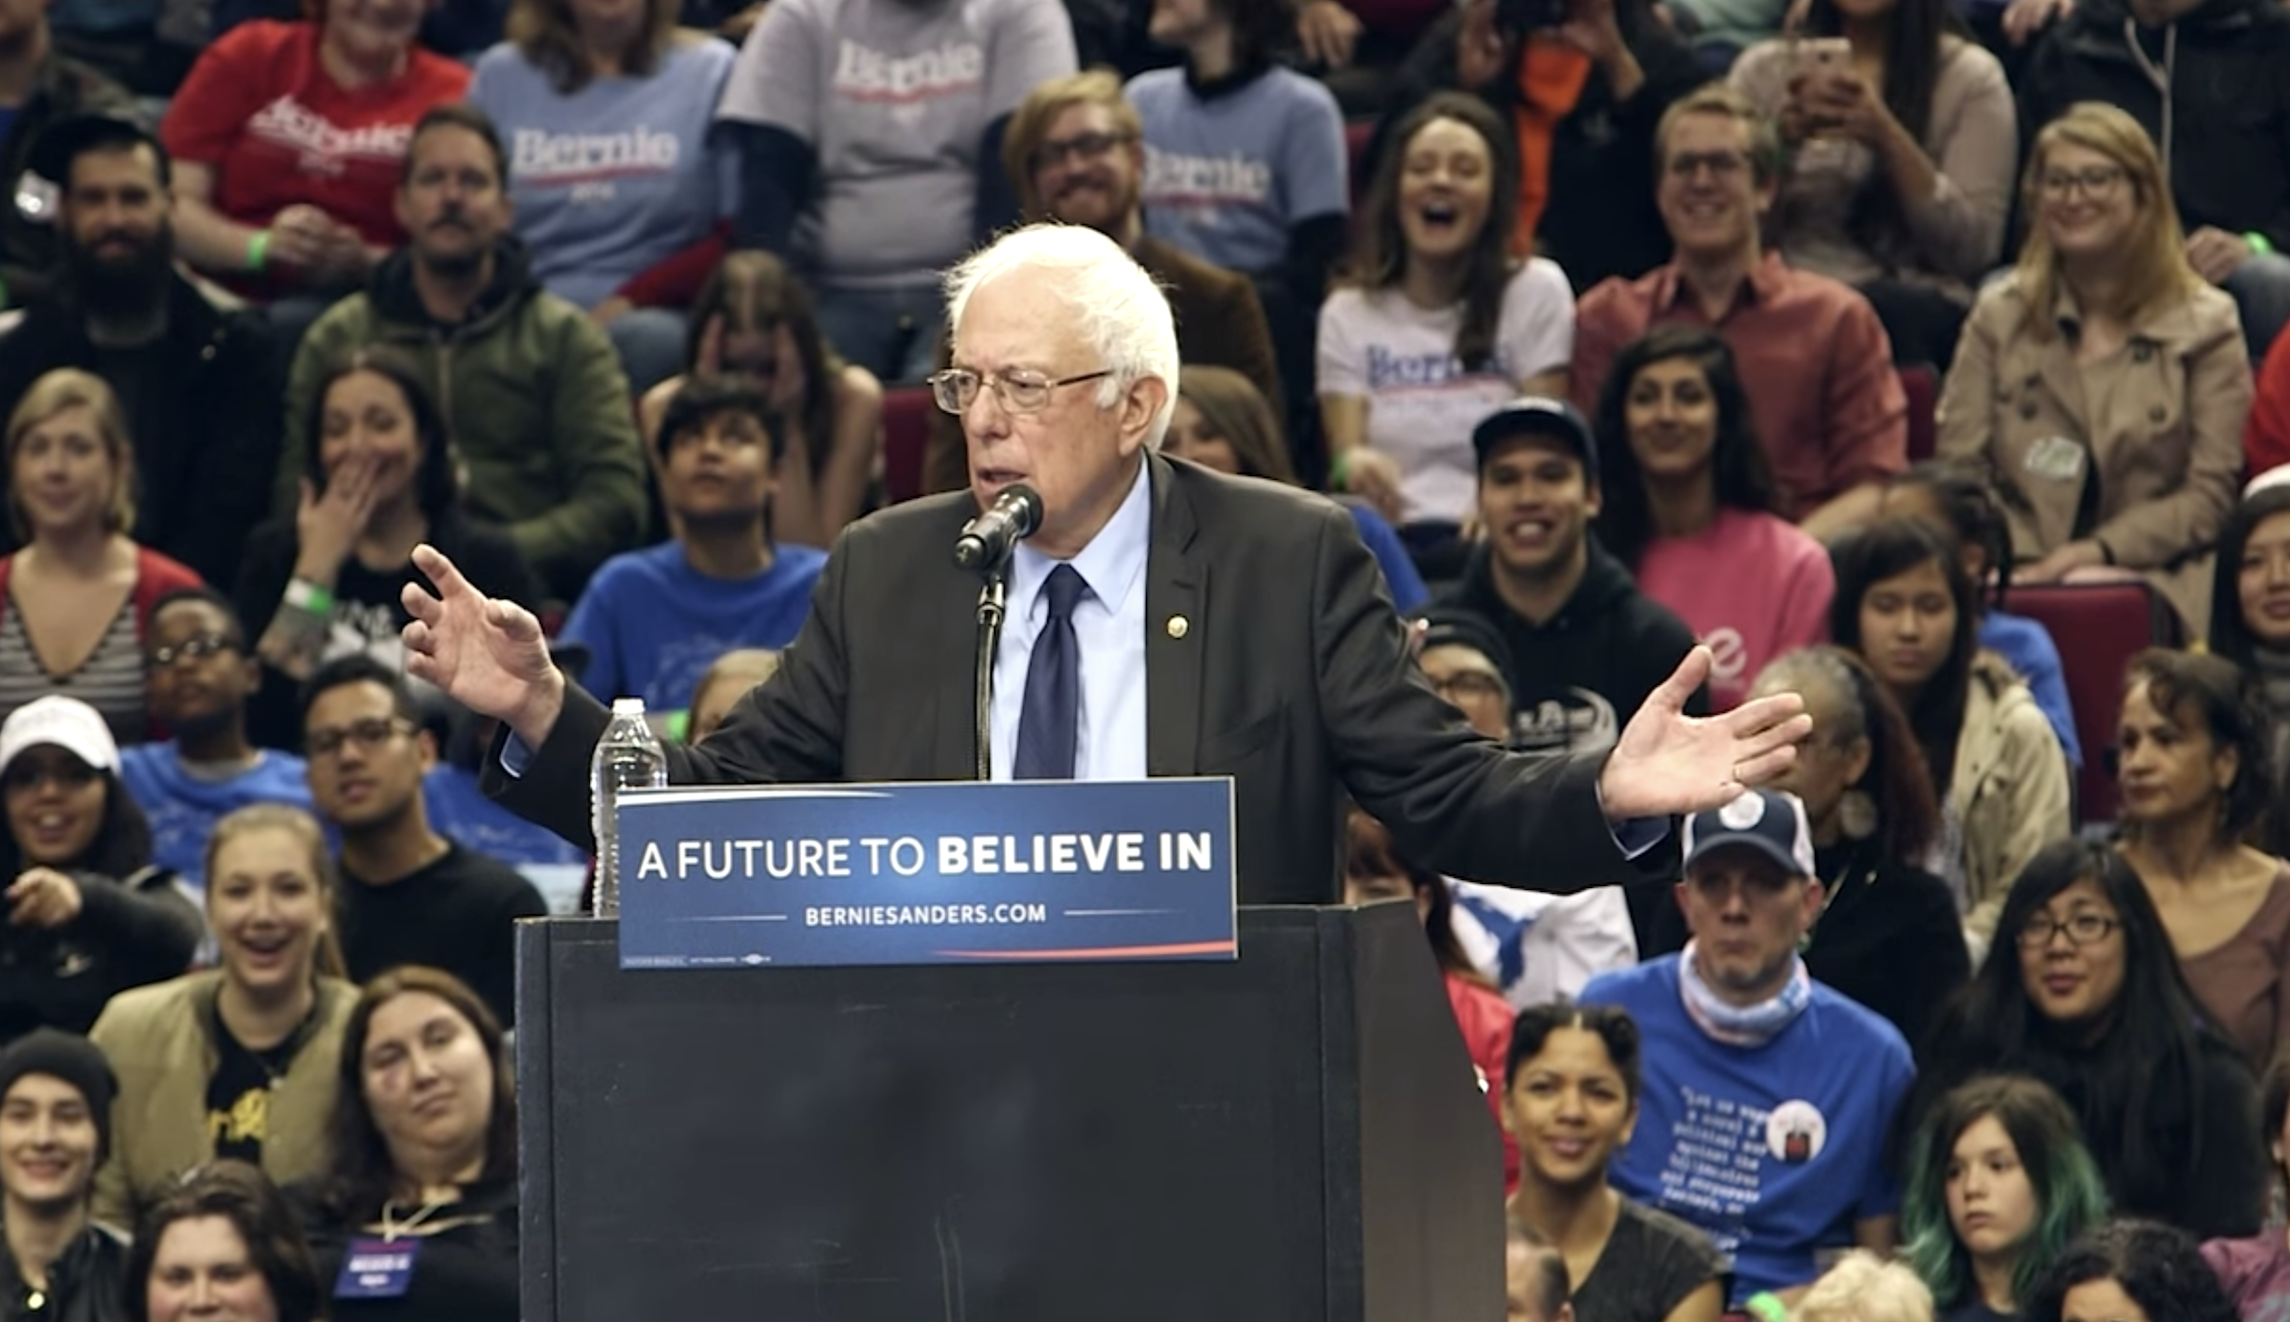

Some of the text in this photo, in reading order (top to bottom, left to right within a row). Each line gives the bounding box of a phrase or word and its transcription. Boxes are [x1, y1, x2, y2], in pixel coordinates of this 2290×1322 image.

[509, 122, 679, 176] Bernie
[637, 831, 1212, 879] A FUTURE TO BELIEVE IN
[805, 904, 1046, 927] BERNIESANDERS.COM
